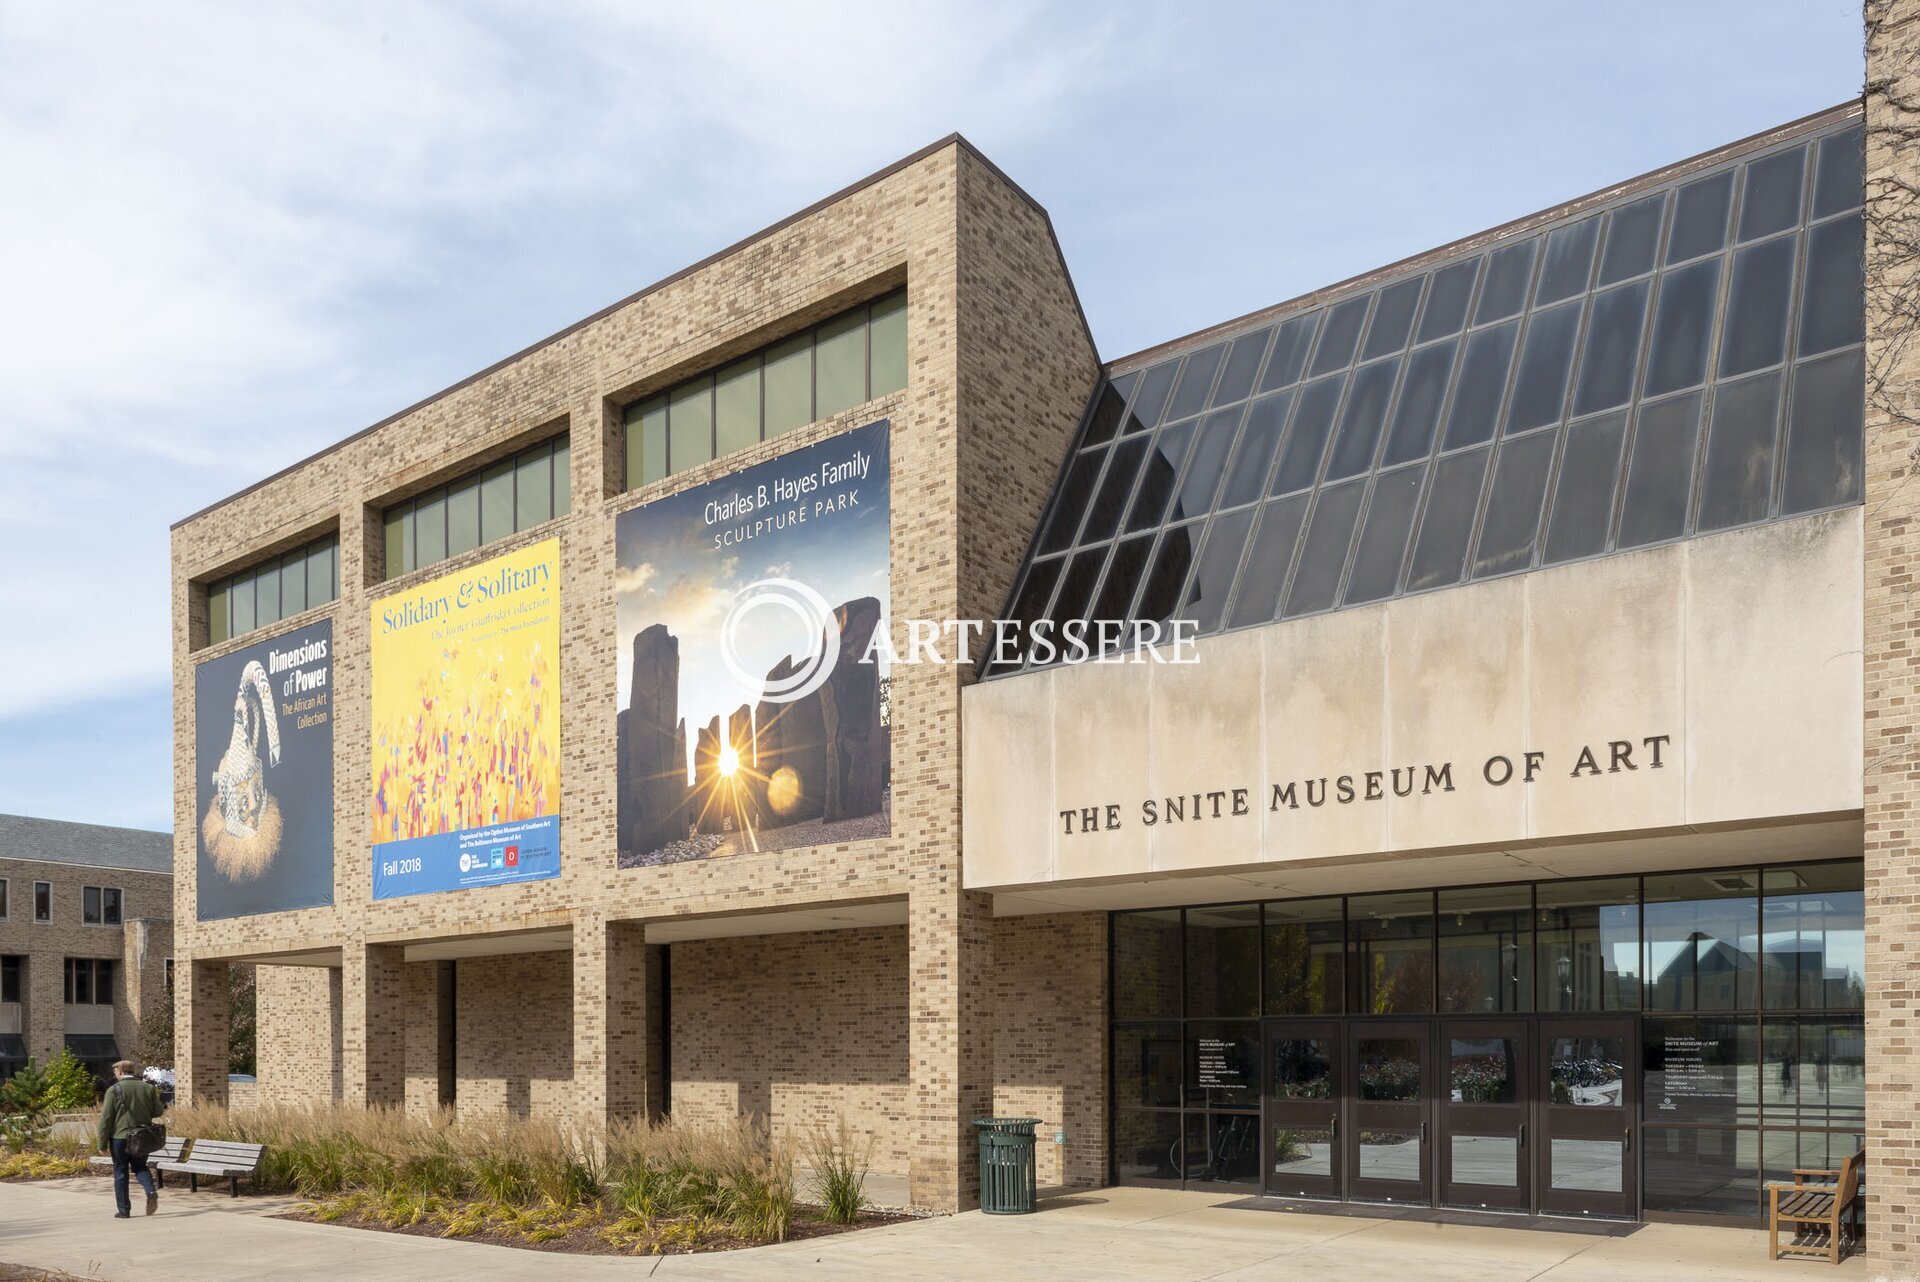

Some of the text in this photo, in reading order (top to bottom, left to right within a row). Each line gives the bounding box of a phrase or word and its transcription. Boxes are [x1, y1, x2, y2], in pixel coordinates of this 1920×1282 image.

[705, 450, 870, 525] Charles B. Hayes Family
[714, 489, 860, 550] SCULPTURE PARK
[383, 561, 552, 635] Solidary & Solitary
[269, 639, 327, 675] Dimensions
[283, 667, 327, 697] of Power
[282, 692, 327, 716] The African Art
[297, 712, 327, 729] Collection
[1059, 734, 1670, 835] THE SNITE MUSEUM OF ART
[383, 857, 422, 877] Fall 2018
